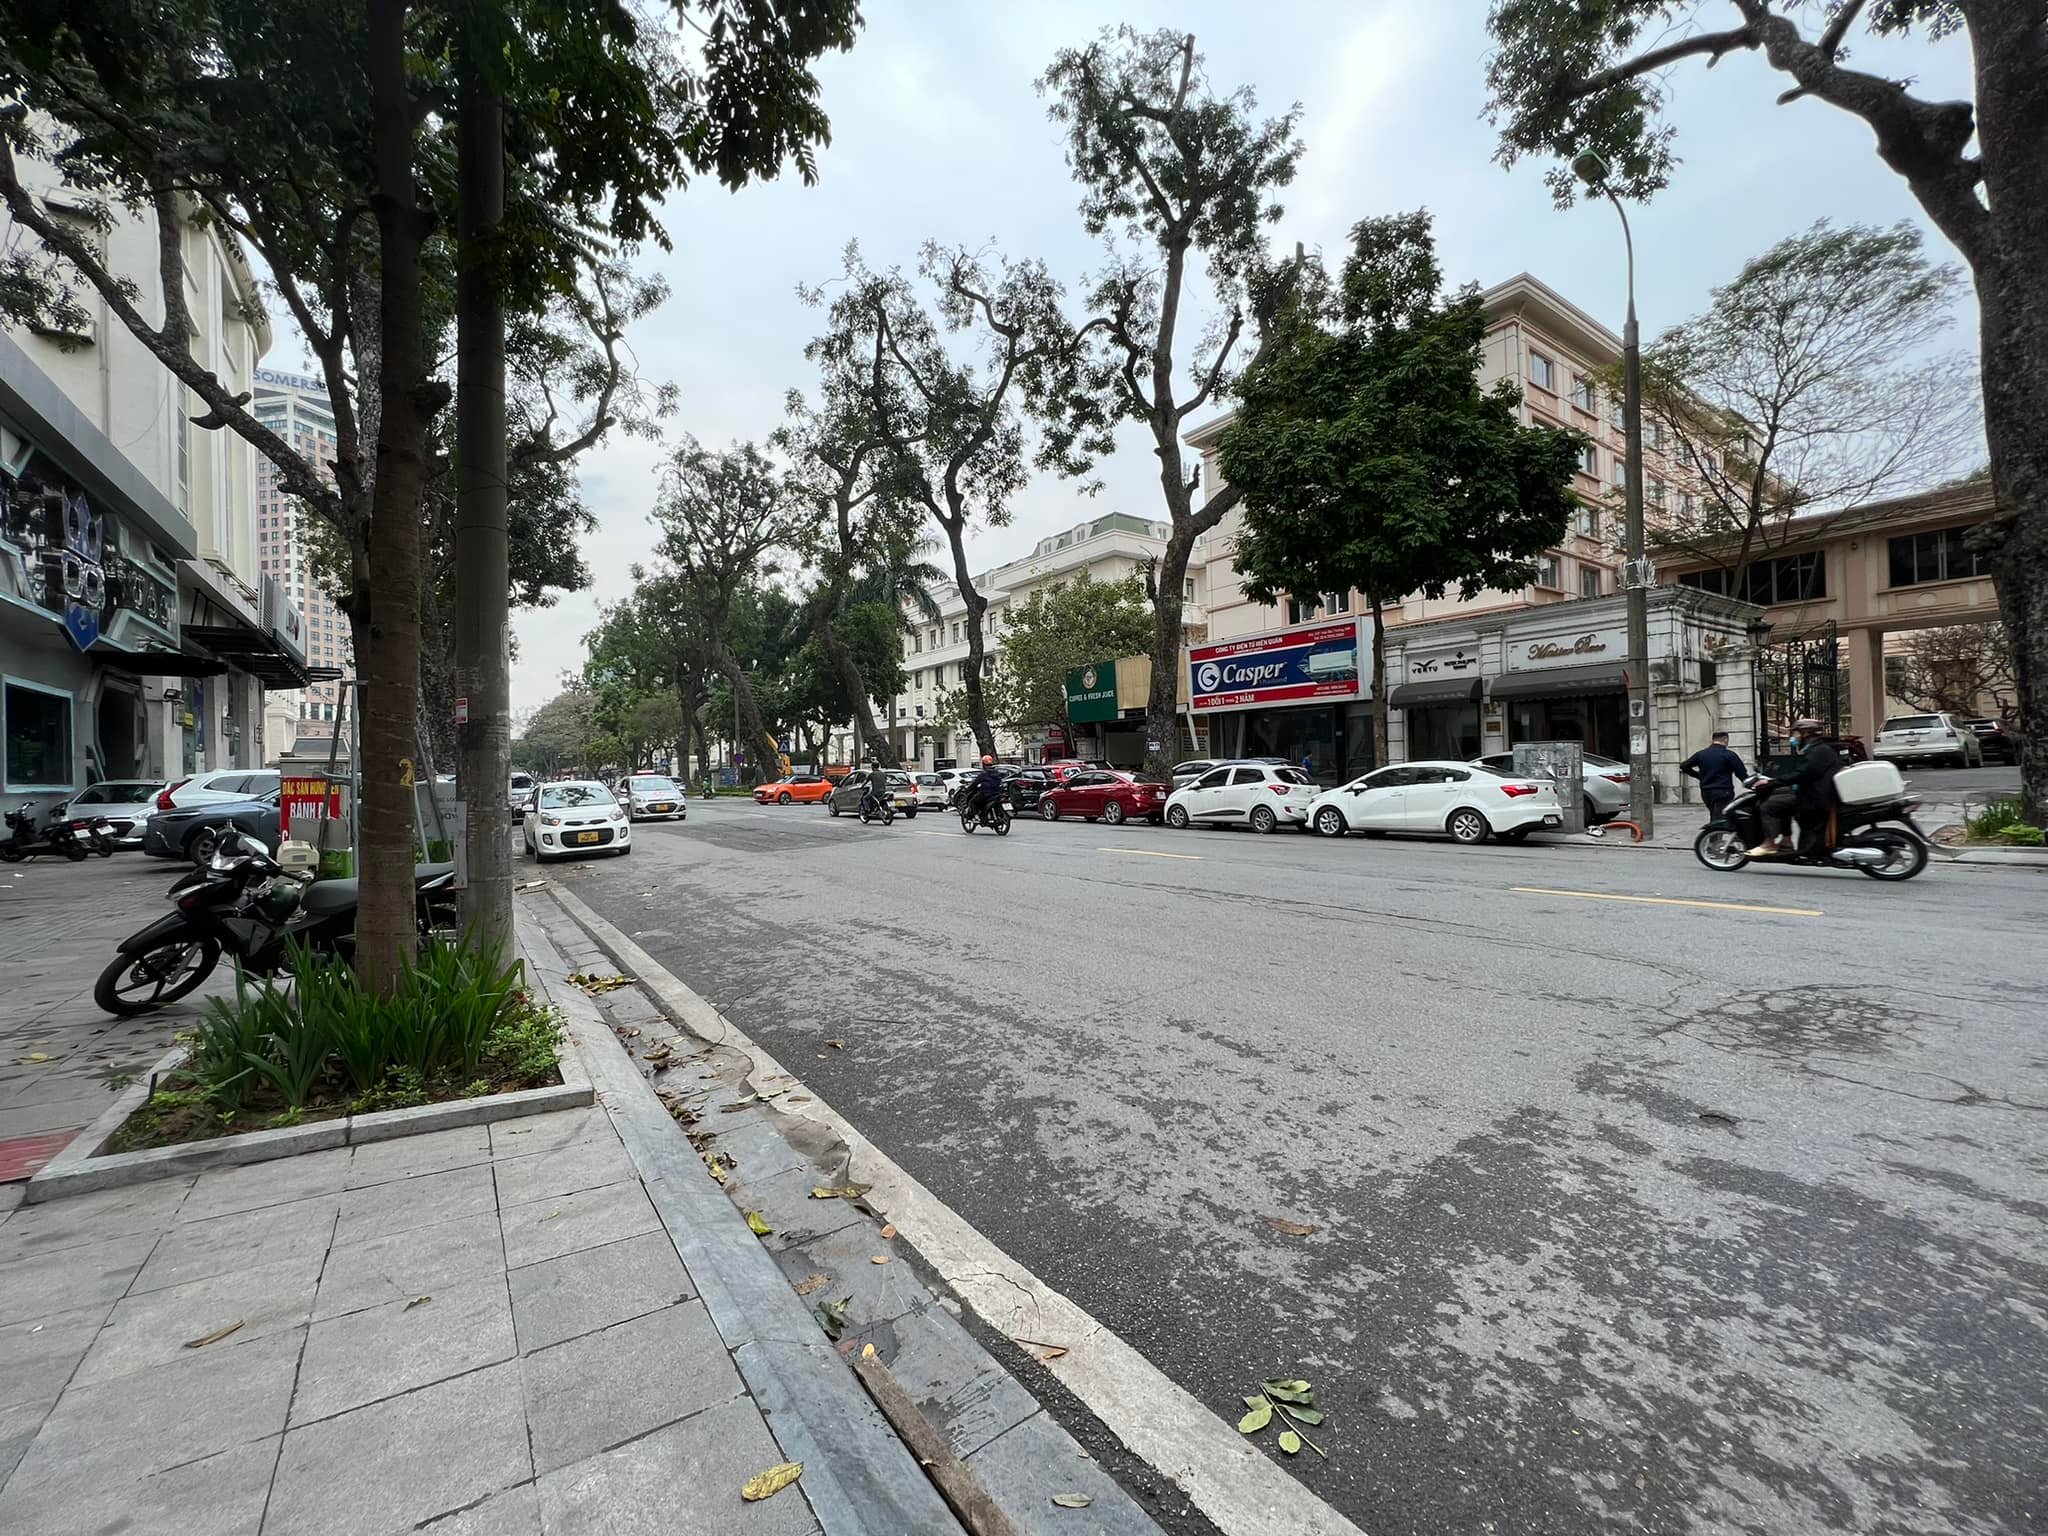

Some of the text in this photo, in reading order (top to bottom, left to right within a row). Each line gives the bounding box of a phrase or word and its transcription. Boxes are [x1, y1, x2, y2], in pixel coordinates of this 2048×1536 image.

[1223, 662, 1284, 686] Casper
[1412, 666, 1438, 674] VERTU
[290, 798, 316, 819] BÁNH
